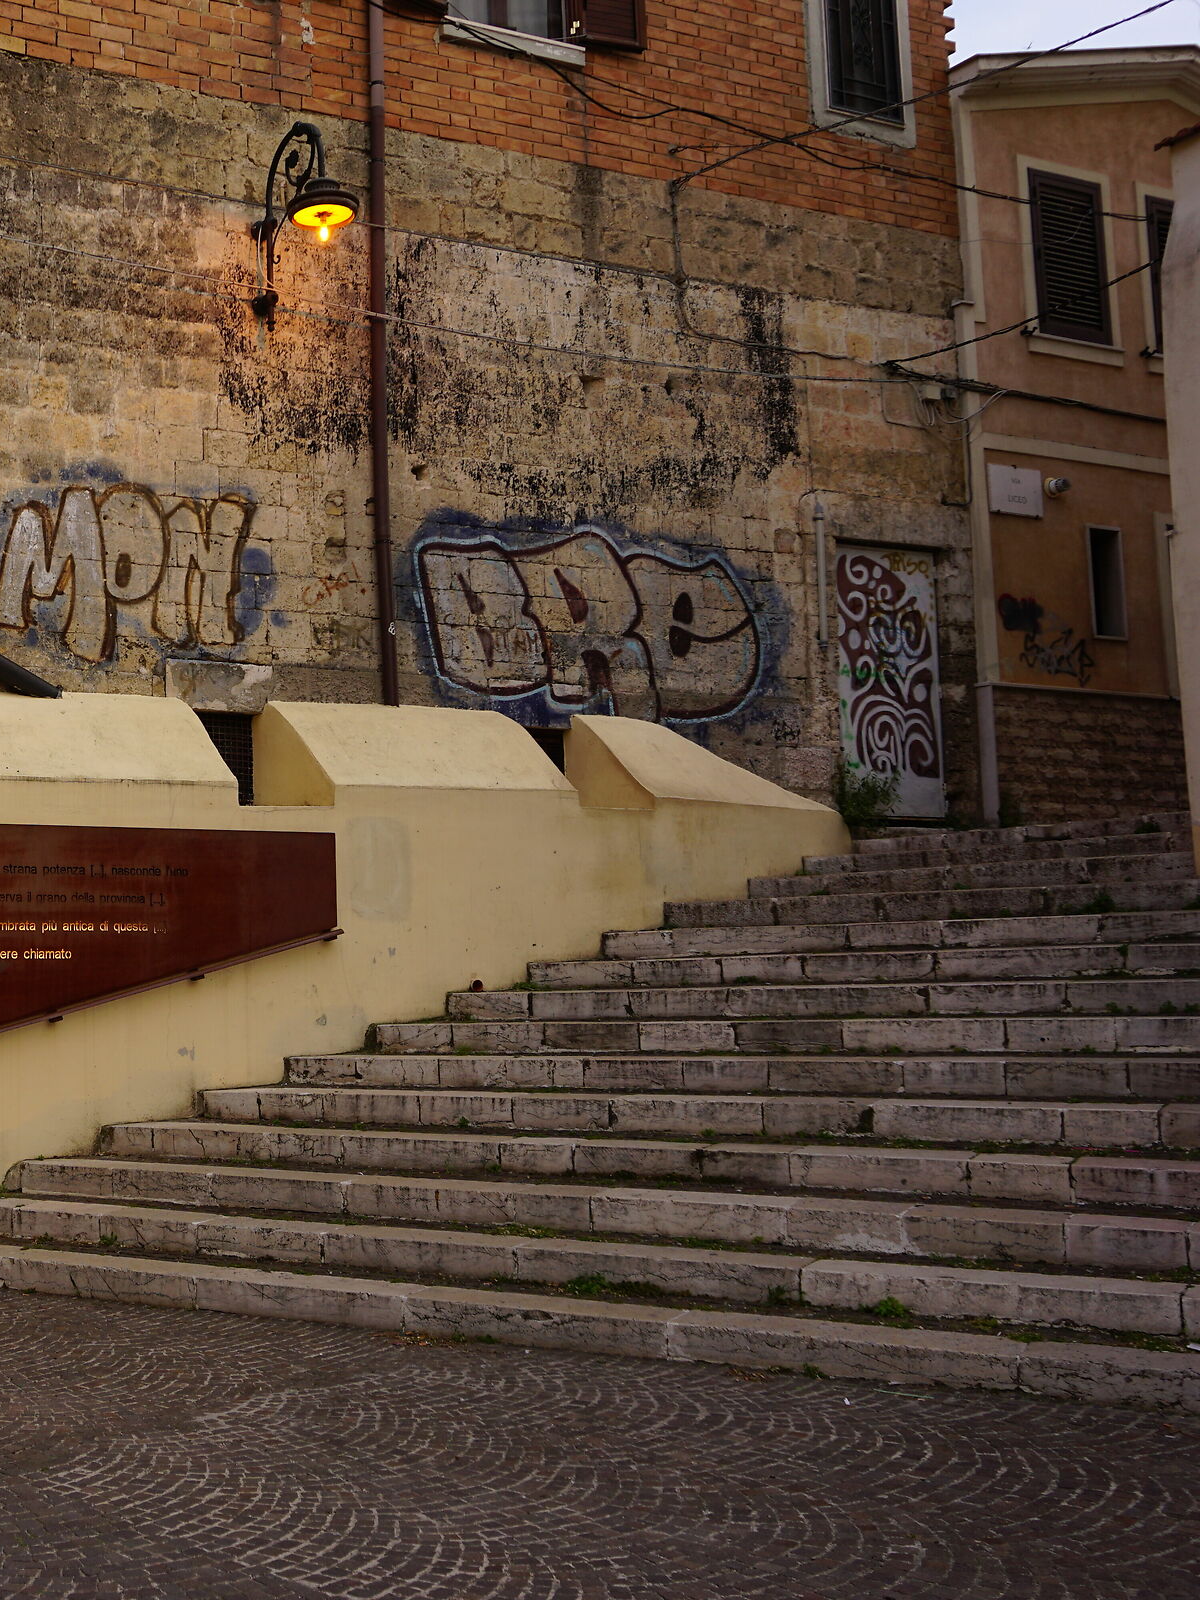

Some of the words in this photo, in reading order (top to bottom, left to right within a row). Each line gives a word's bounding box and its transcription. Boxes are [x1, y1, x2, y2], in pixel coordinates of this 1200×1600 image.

[3, 864, 37, 875] strana
[43, 865, 85, 877] potenza
[112, 866, 161, 877] nasconde
[166, 866, 188, 877] l'uno
[27, 892, 32, 902] il
[36, 894, 66, 904] grano
[72, 893, 94, 903] della
[100, 893, 145, 905] provincia
[42, 921, 57, 933] più
[62, 921, 94, 932] antica
[99, 921, 109, 932] di
[114, 922, 148, 933] questa
[23, 948, 72, 960] chiamato
